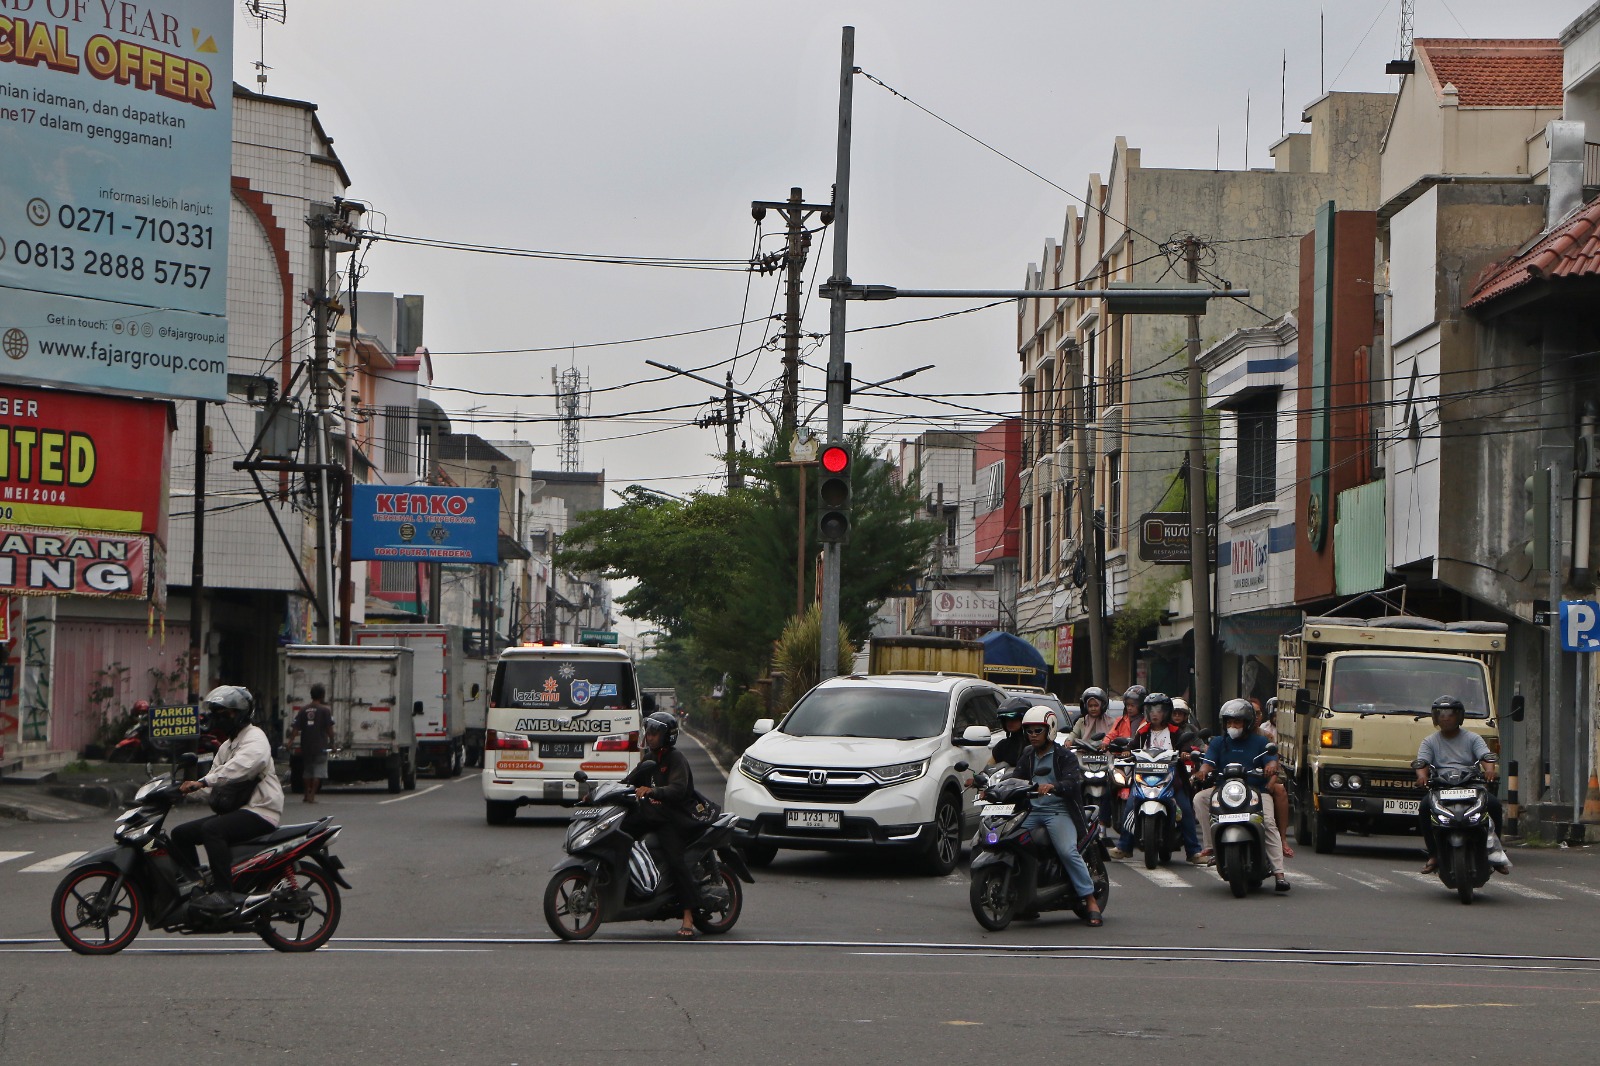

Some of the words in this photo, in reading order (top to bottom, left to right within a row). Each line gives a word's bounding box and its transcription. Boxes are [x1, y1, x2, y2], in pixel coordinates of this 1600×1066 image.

[101, 0, 181, 47] YEAR
[84, 34, 216, 109] OFFER
[33, 87, 89, 114] idaman,
[93, 100, 119, 117] dan
[123, 105, 186, 129] dapatkan
[39, 113, 83, 133] dalam
[87, 124, 172, 149] genggaman!
[99, 187, 150, 205] informasi
[152, 194, 178, 210] lebih
[181, 197, 213, 216] lanjut:
[14, 240, 75, 271] 0813
[83, 250, 144, 280] 2888
[154, 259, 211, 289] 5757
[47, 313, 65, 326] Get
[67, 317, 76, 326] in
[78, 318, 108, 330] touch:
[158, 326, 225, 344] @fajargroup.id
[39, 340, 225, 374] www.fajargroup.com
[4, 486, 29, 500] MEI
[33, 488, 66, 503] 2004
[417, 515, 423, 523] &
[0, 533, 128, 560] ARAN
[374, 548, 398, 557] TOKO
[399, 549, 428, 557] PUTRA
[429, 549, 472, 558] MERDEKA
[1232, 539, 1254, 575] INTAN
[956, 595, 995, 609] Sista
[1567, 604, 1595, 646] P
[513, 688, 560, 702] lazismu
[152, 716, 196, 727] KHUSUS
[154, 706, 194, 718] PARKIR
[153, 726, 197, 737] GOLDEN
[515, 719, 611, 732] AMBULANCE
[1384, 800, 1395, 809] AD
[788, 811, 798, 821] AD
[803, 811, 824, 822] 1731
[828, 812, 839, 823] PU
